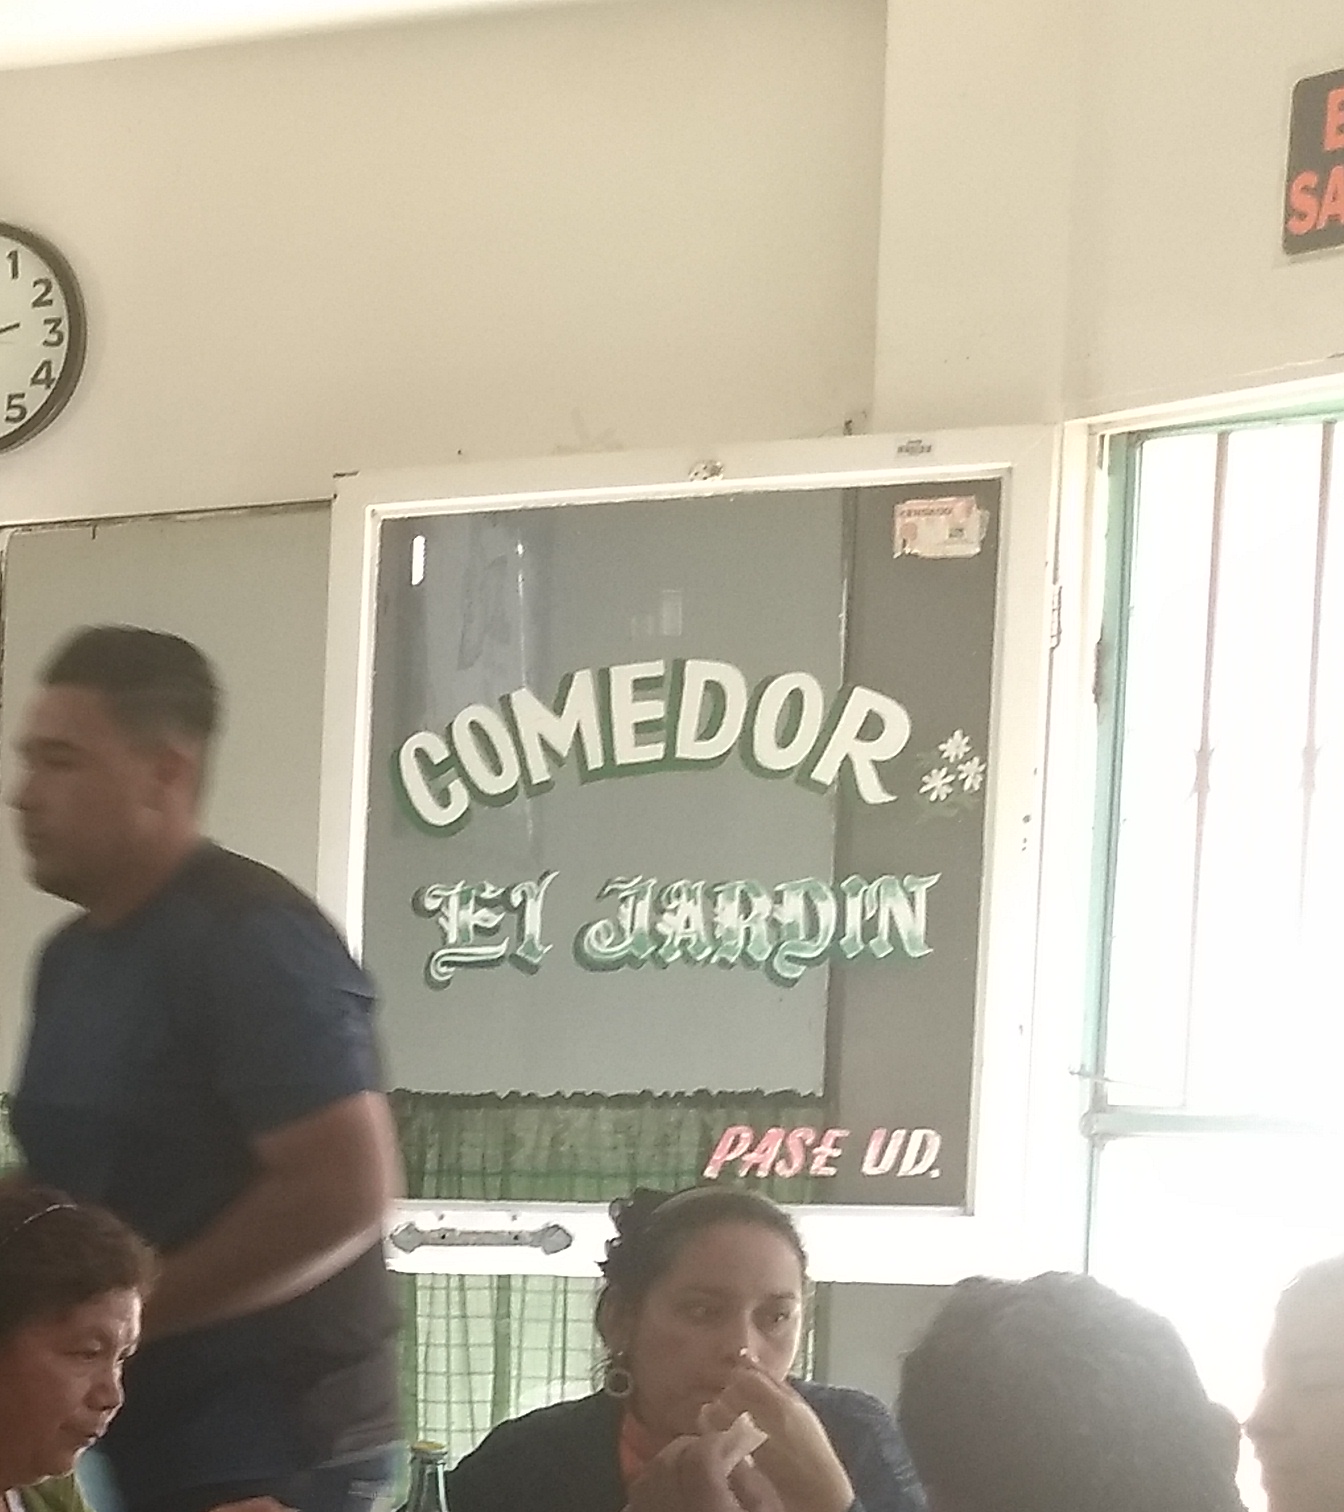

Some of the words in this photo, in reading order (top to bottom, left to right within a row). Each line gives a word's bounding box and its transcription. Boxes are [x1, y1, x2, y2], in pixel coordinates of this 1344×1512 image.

[6, 248, 19, 280] 1
[31, 277, 54, 309] 2
[42, 317, 63, 348] 3
[29, 359, 55, 390] 4
[5, 392, 28, 423] 5
[394, 658, 912, 831] COMEDOR
[576, 870, 942, 984] JARDIN
[702, 1124, 851, 1180] PASE
[861, 1126, 943, 1180] UD.
